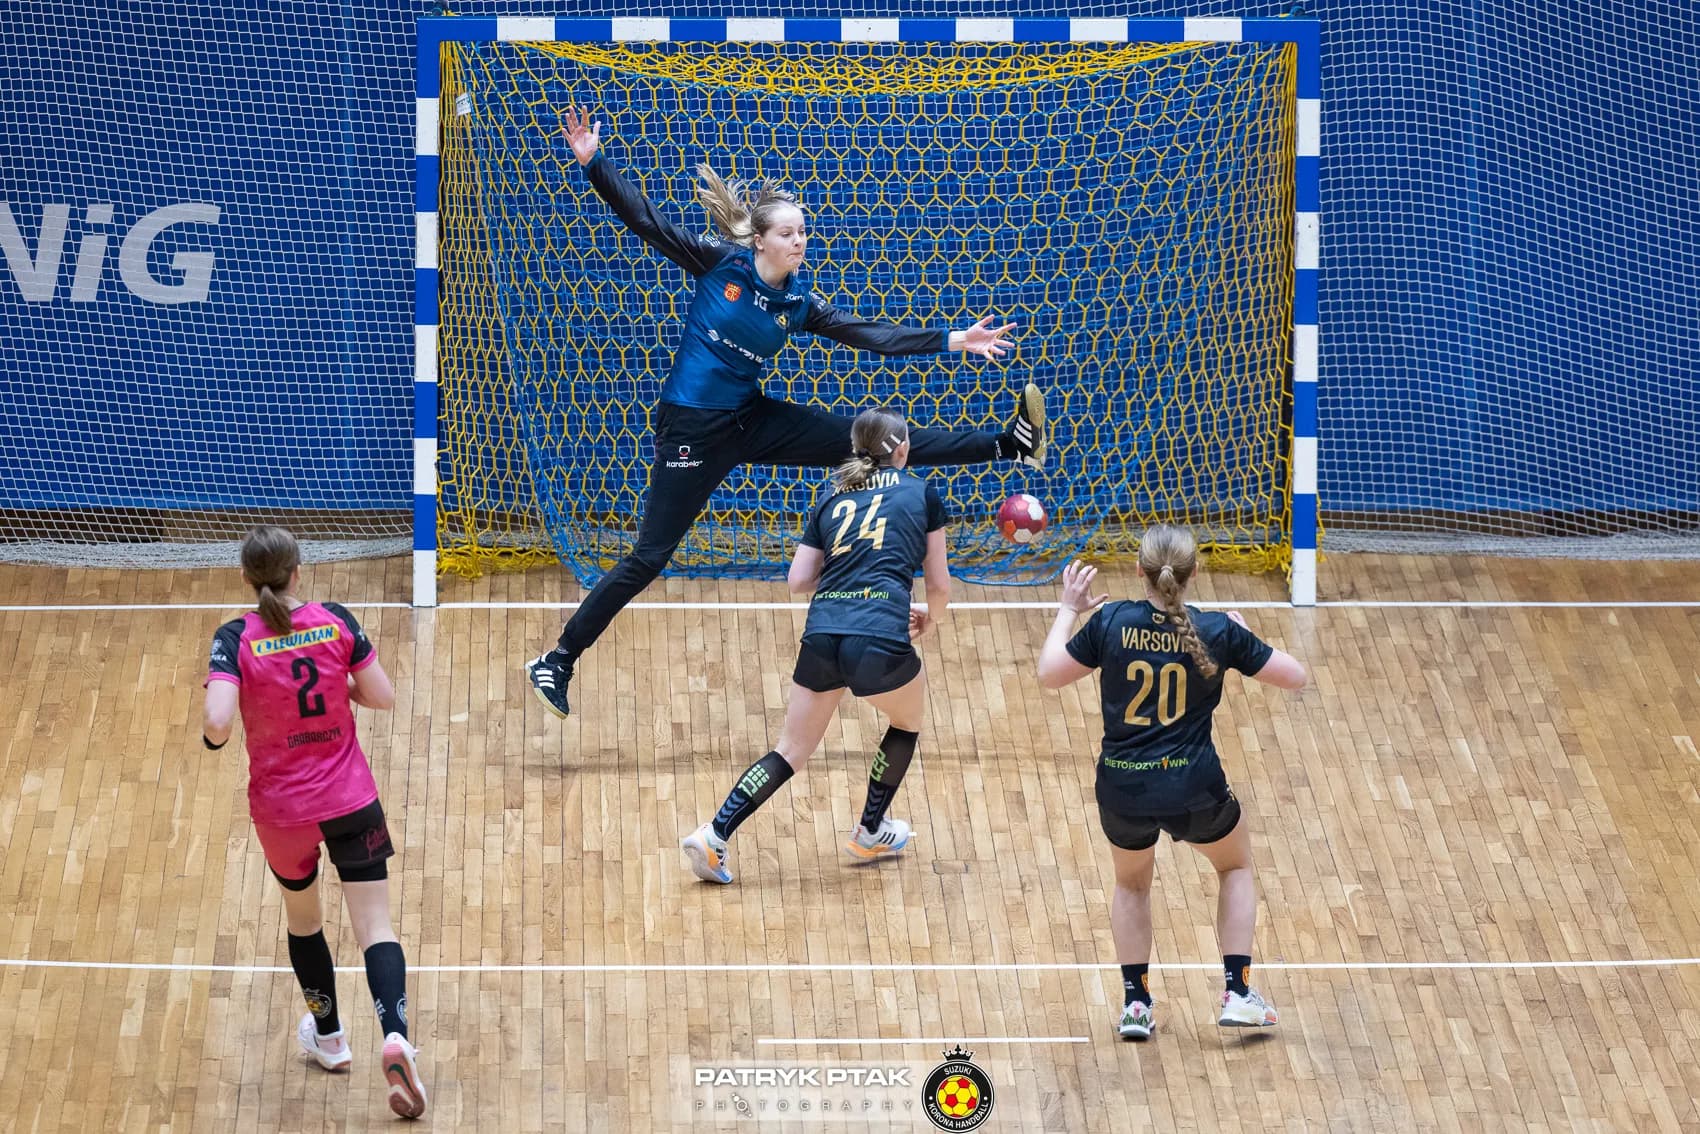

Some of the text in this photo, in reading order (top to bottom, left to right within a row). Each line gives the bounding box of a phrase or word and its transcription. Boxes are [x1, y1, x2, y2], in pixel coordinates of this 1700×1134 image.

[831, 471, 900, 497] SOVIA
[831, 494, 888, 557] 24
[273, 626, 334, 650] LEWIATAN
[1121, 626, 1188, 653] VARSOVI
[291, 657, 326, 718] 2
[1124, 660, 1188, 726] 20
